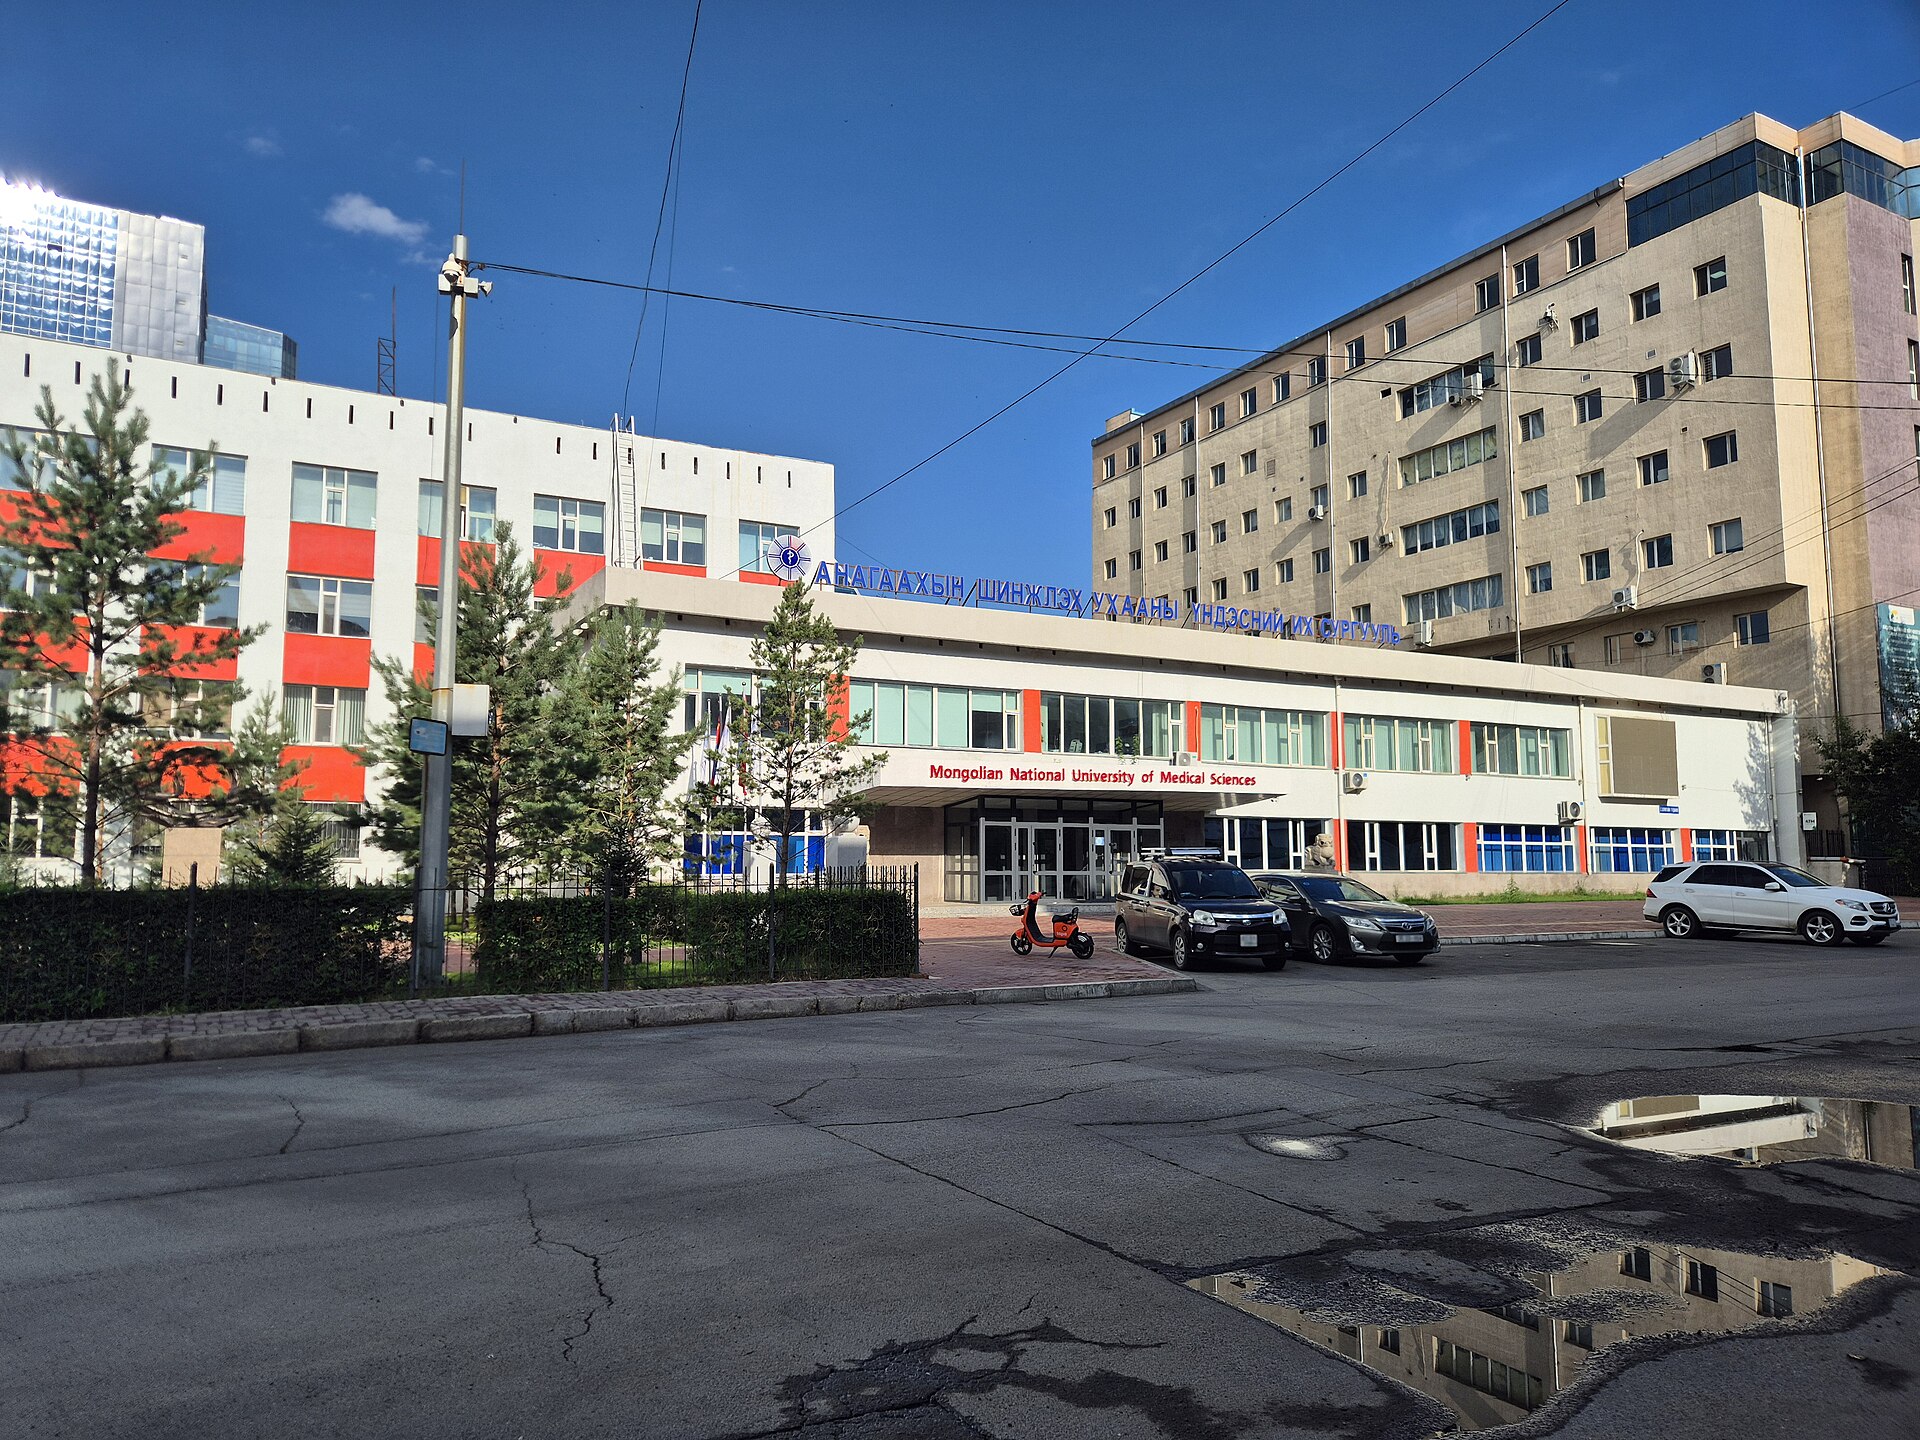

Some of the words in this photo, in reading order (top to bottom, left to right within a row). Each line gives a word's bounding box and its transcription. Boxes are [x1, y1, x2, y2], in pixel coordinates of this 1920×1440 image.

[815, 560, 965, 599] АНАГААХЫН
[977, 577, 1084, 612] ШИНЖЛЭХ
[1093, 591, 1179, 621] УХААНЫ
[1291, 614, 1315, 637] ИХ
[1320, 617, 1401, 645] СУРГУУЛЬ
[929, 764, 1004, 782] Mongolian
[1009, 768, 1066, 783] National
[1072, 769, 1136, 787] University
[1140, 771, 1155, 784] of
[1159, 771, 1206, 786] Medical
[1210, 773, 1257, 787] Sciences
